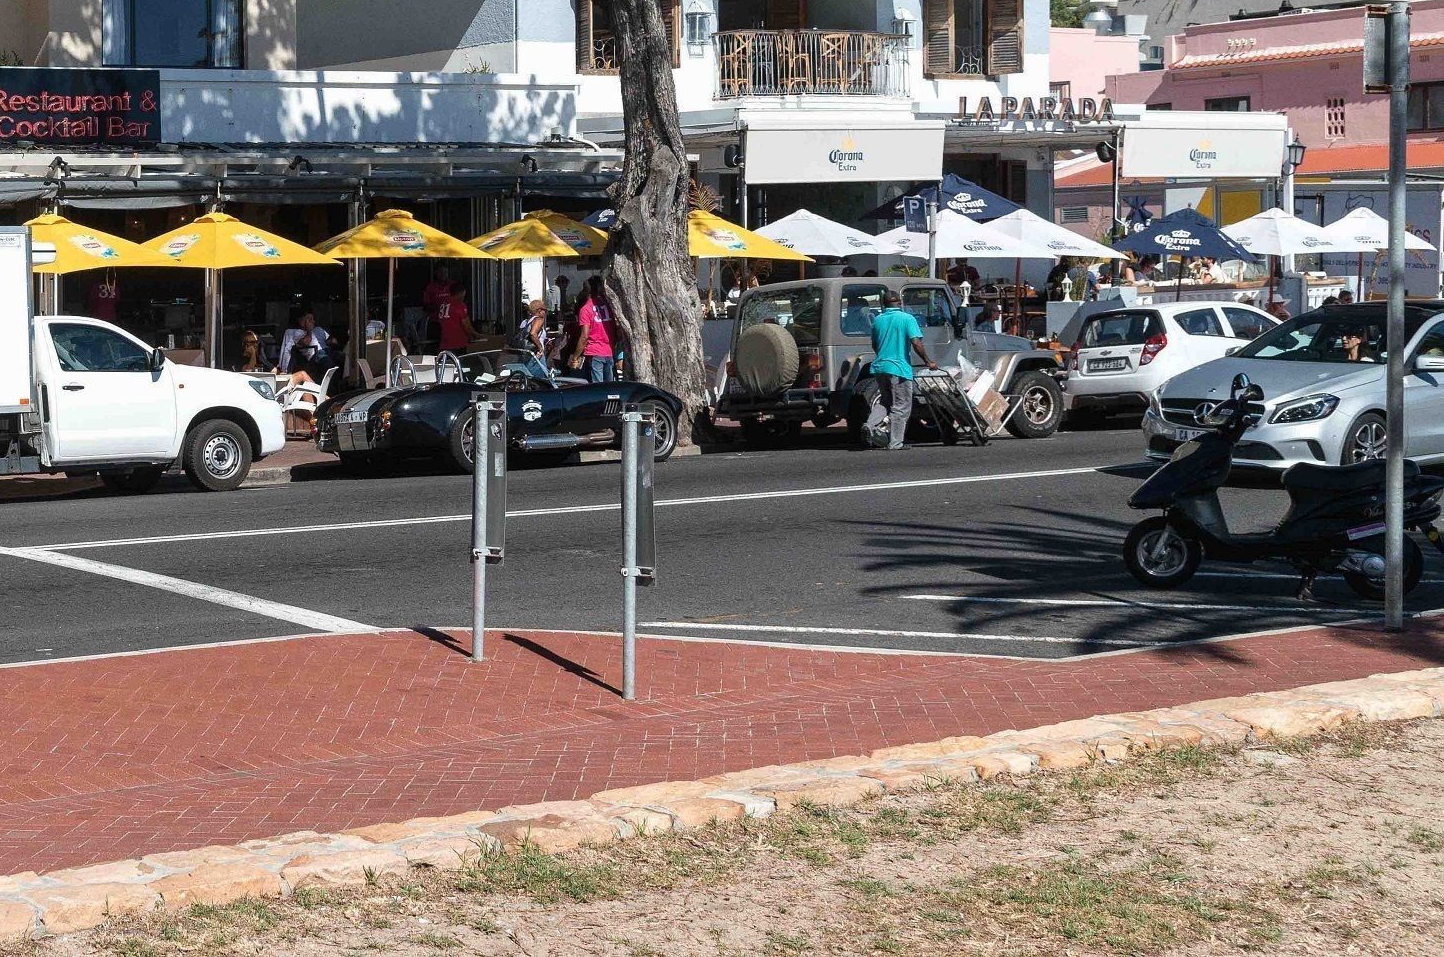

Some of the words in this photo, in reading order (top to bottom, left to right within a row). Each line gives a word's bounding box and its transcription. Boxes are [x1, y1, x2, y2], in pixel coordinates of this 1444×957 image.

[140, 90, 157, 111] &
[959, 96, 996, 122] LA
[1001, 97, 1115, 123] PARADA
[108, 116, 152, 137] Bar
[829, 149, 863, 164] Corona
[1189, 149, 1216, 161] Corona
[838, 162, 857, 171] Extra
[909, 199, 919, 214] P
[947, 199, 987, 210] Corona
[1154, 235, 1201, 246] Corona
[963, 243, 1003, 252] Corona
[1165, 243, 1190, 251] Extra
[1179, 430, 1189, 441] CA
